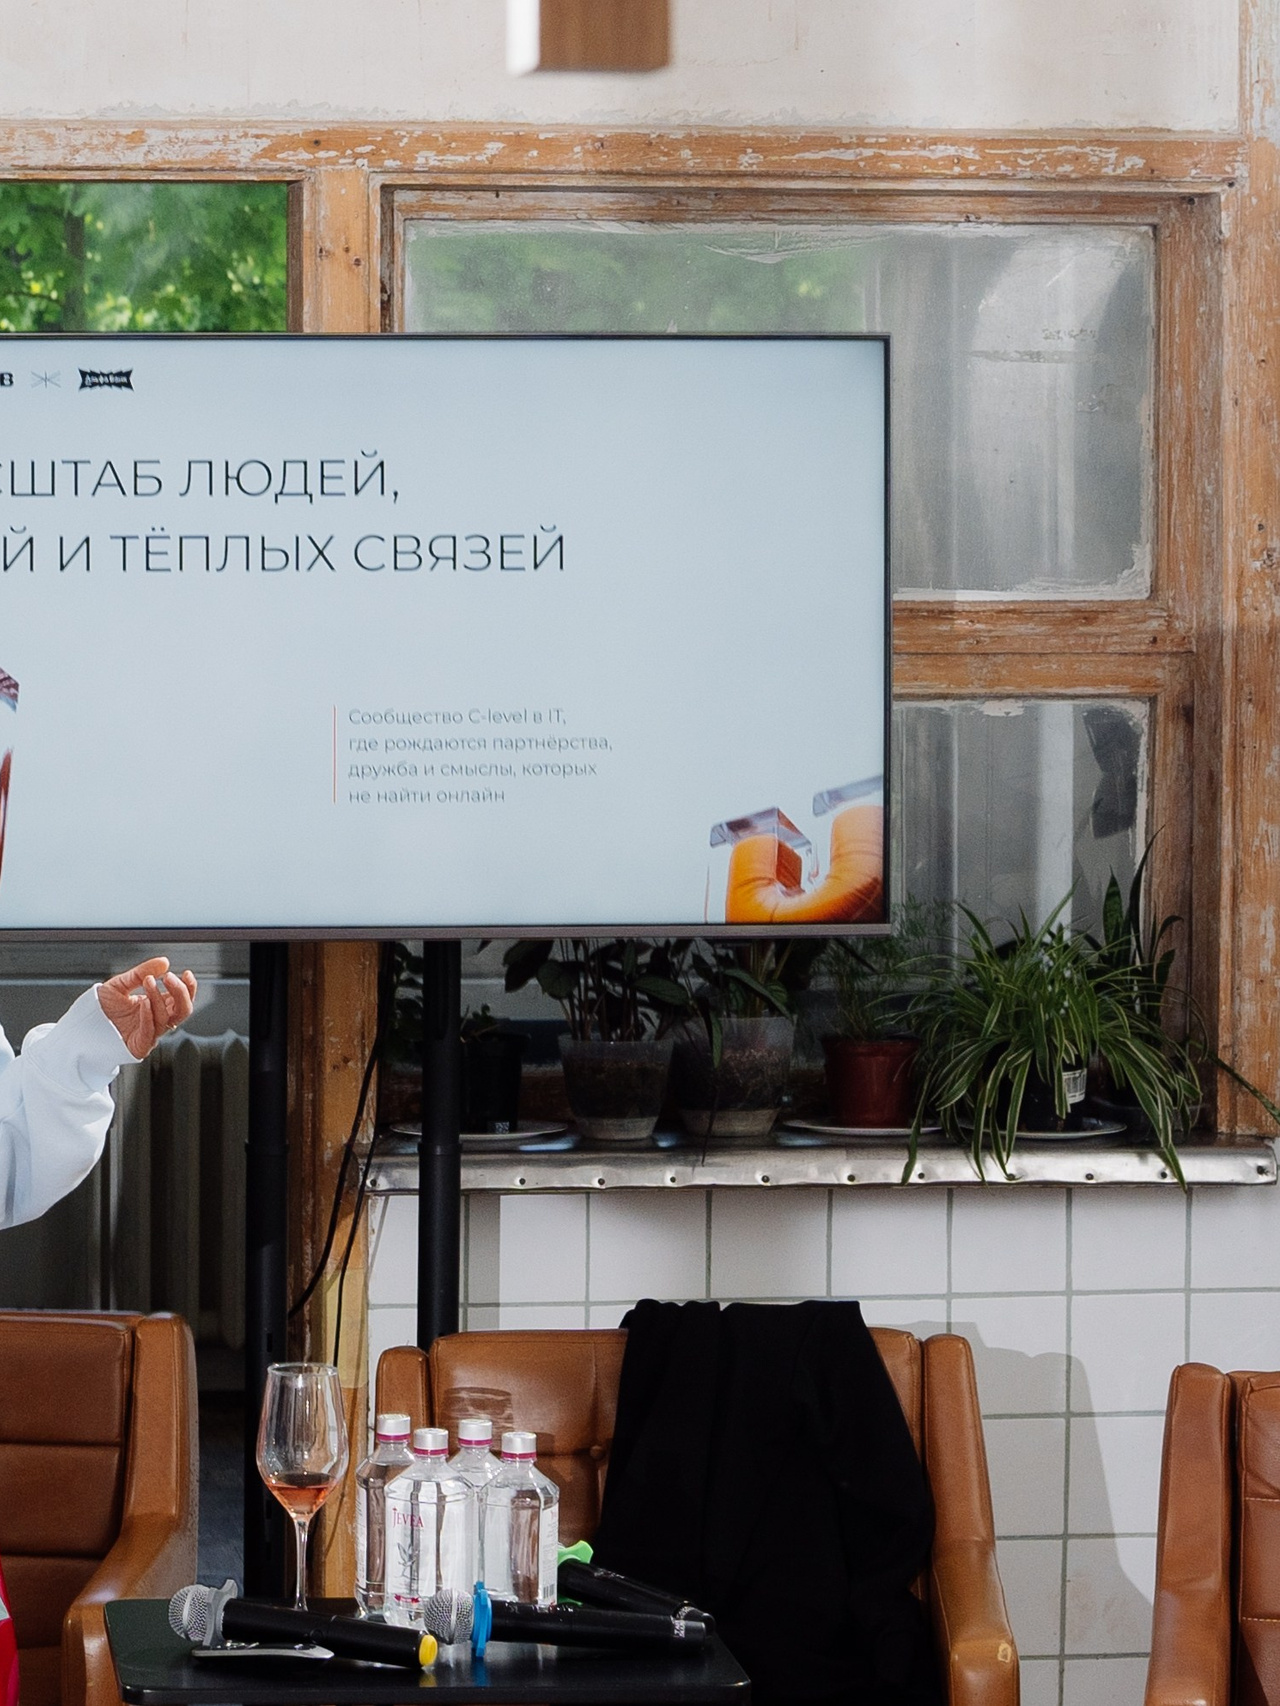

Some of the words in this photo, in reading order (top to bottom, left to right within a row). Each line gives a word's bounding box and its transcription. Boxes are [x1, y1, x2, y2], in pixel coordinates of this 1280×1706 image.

[179, 449, 399, 505] ЛЮДЕЙ,
[59, 536, 91, 572] И
[110, 527, 337, 572] ТЁПЛЫХ
[353, 525, 565, 572] СВЯЗЕЙ
[349, 708, 463, 727] Сообщество
[468, 708, 528, 725] C-level
[533, 713, 543, 725] в
[548, 708, 567, 728] IT,
[349, 740, 379, 753] где
[384, 739, 487, 755] рождаются
[493, 736, 613, 754] партнёрства,
[348, 760, 418, 779] дружба
[424, 764, 435, 776] и
[441, 764, 516, 779] смыслы,
[522, 764, 597, 779] которых
[349, 791, 371, 803] не
[377, 787, 431, 803] найти
[437, 787, 505, 803] онлайн
